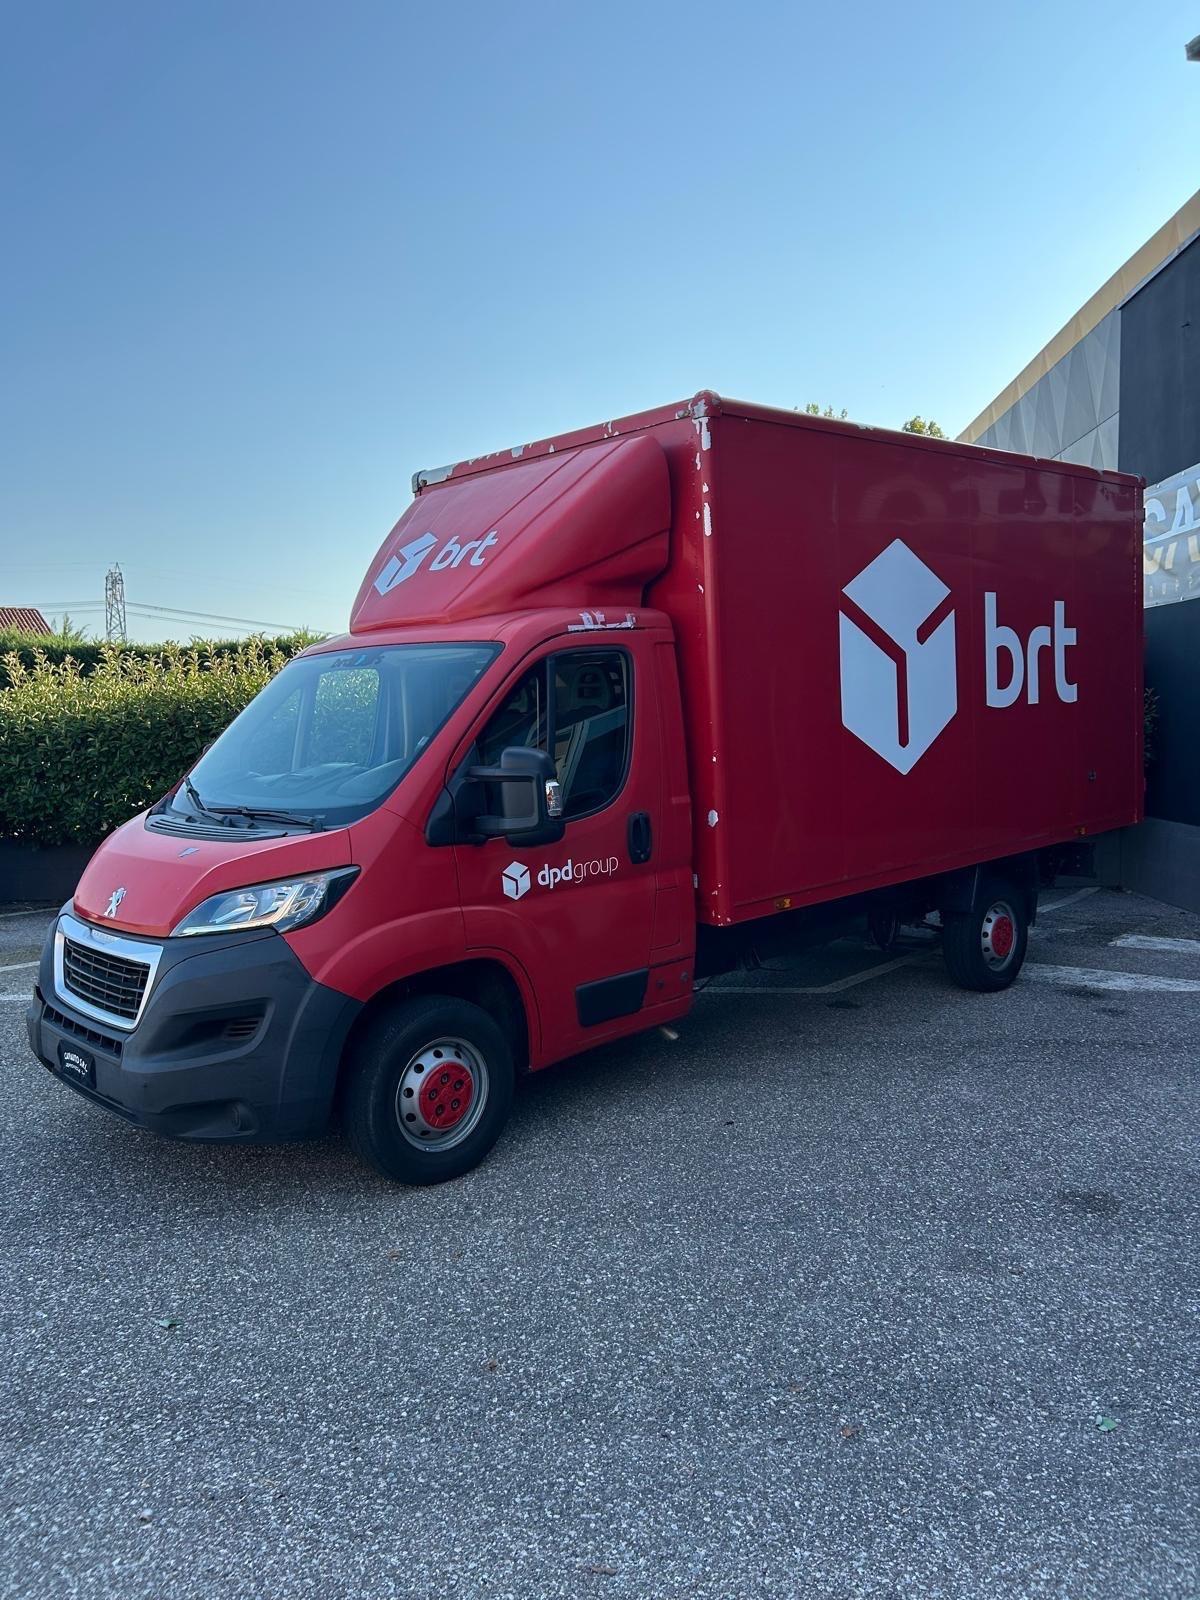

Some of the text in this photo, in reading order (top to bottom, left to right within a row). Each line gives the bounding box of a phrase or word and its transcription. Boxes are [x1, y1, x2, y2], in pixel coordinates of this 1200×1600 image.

[429, 531, 498, 571] brt
[984, 591, 1078, 708] brt
[537, 856, 619, 889] dpdgroup
